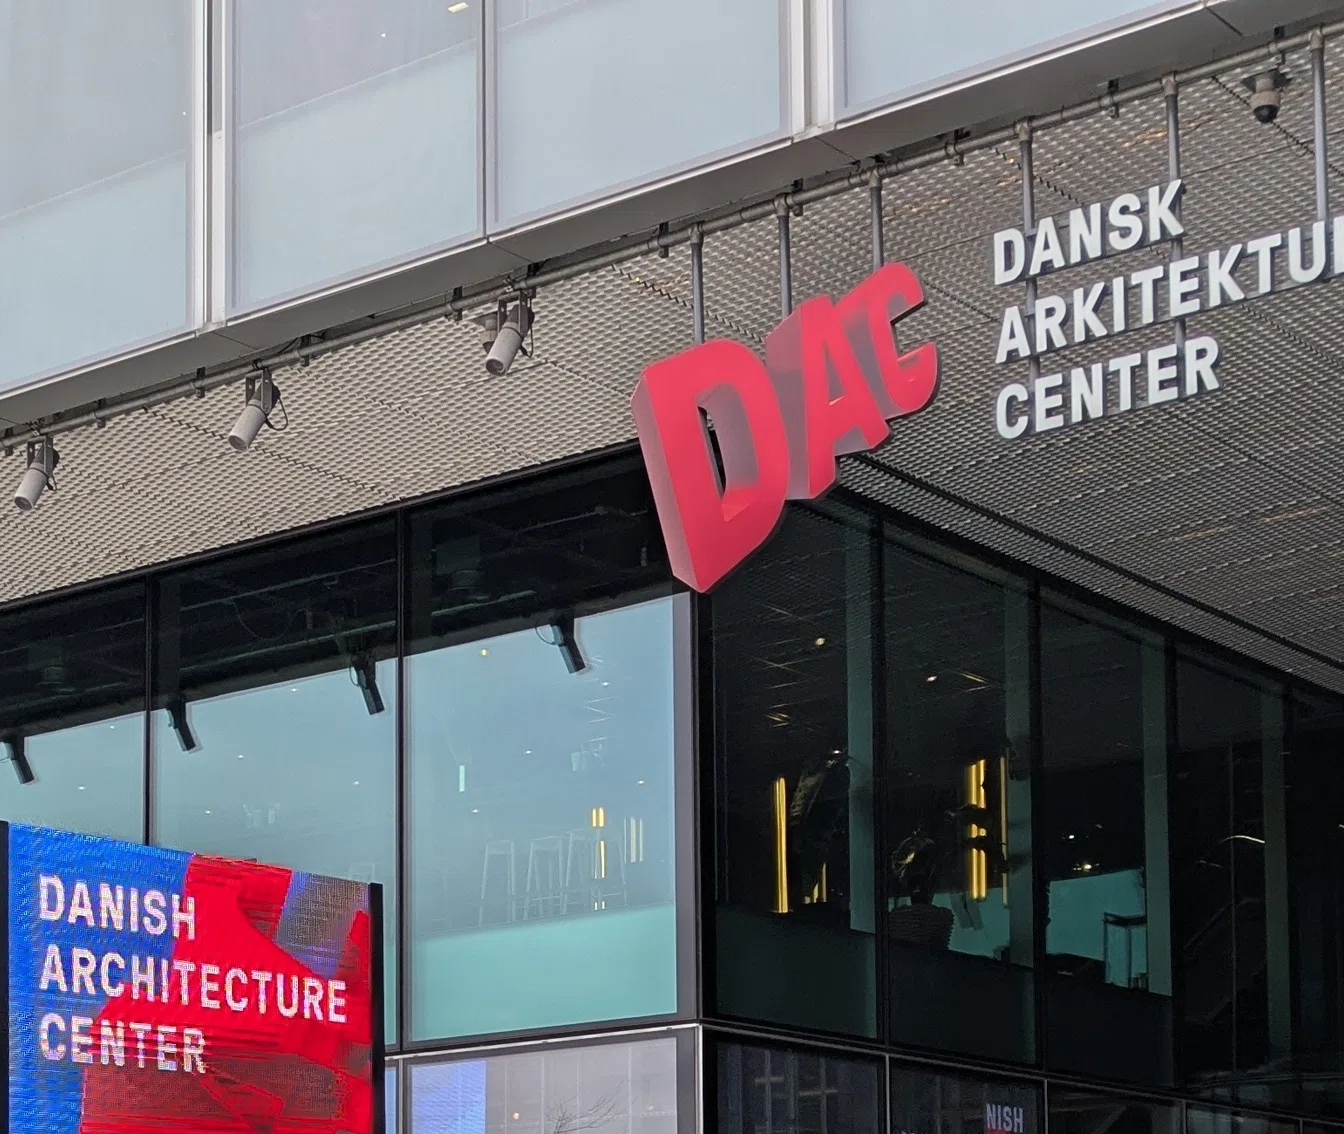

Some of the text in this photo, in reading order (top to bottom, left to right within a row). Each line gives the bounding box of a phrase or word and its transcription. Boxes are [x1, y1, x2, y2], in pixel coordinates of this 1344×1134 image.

[993, 178, 1185, 286] DANSK
[632, 261, 939, 593] DAC
[995, 335, 1221, 441] CENTER
[38, 873, 196, 940] DANISH
[38, 944, 348, 1024] ARCHITECTURE
[38, 1011, 207, 1074] CENTER
[986, 1103, 1025, 1133] NISH
